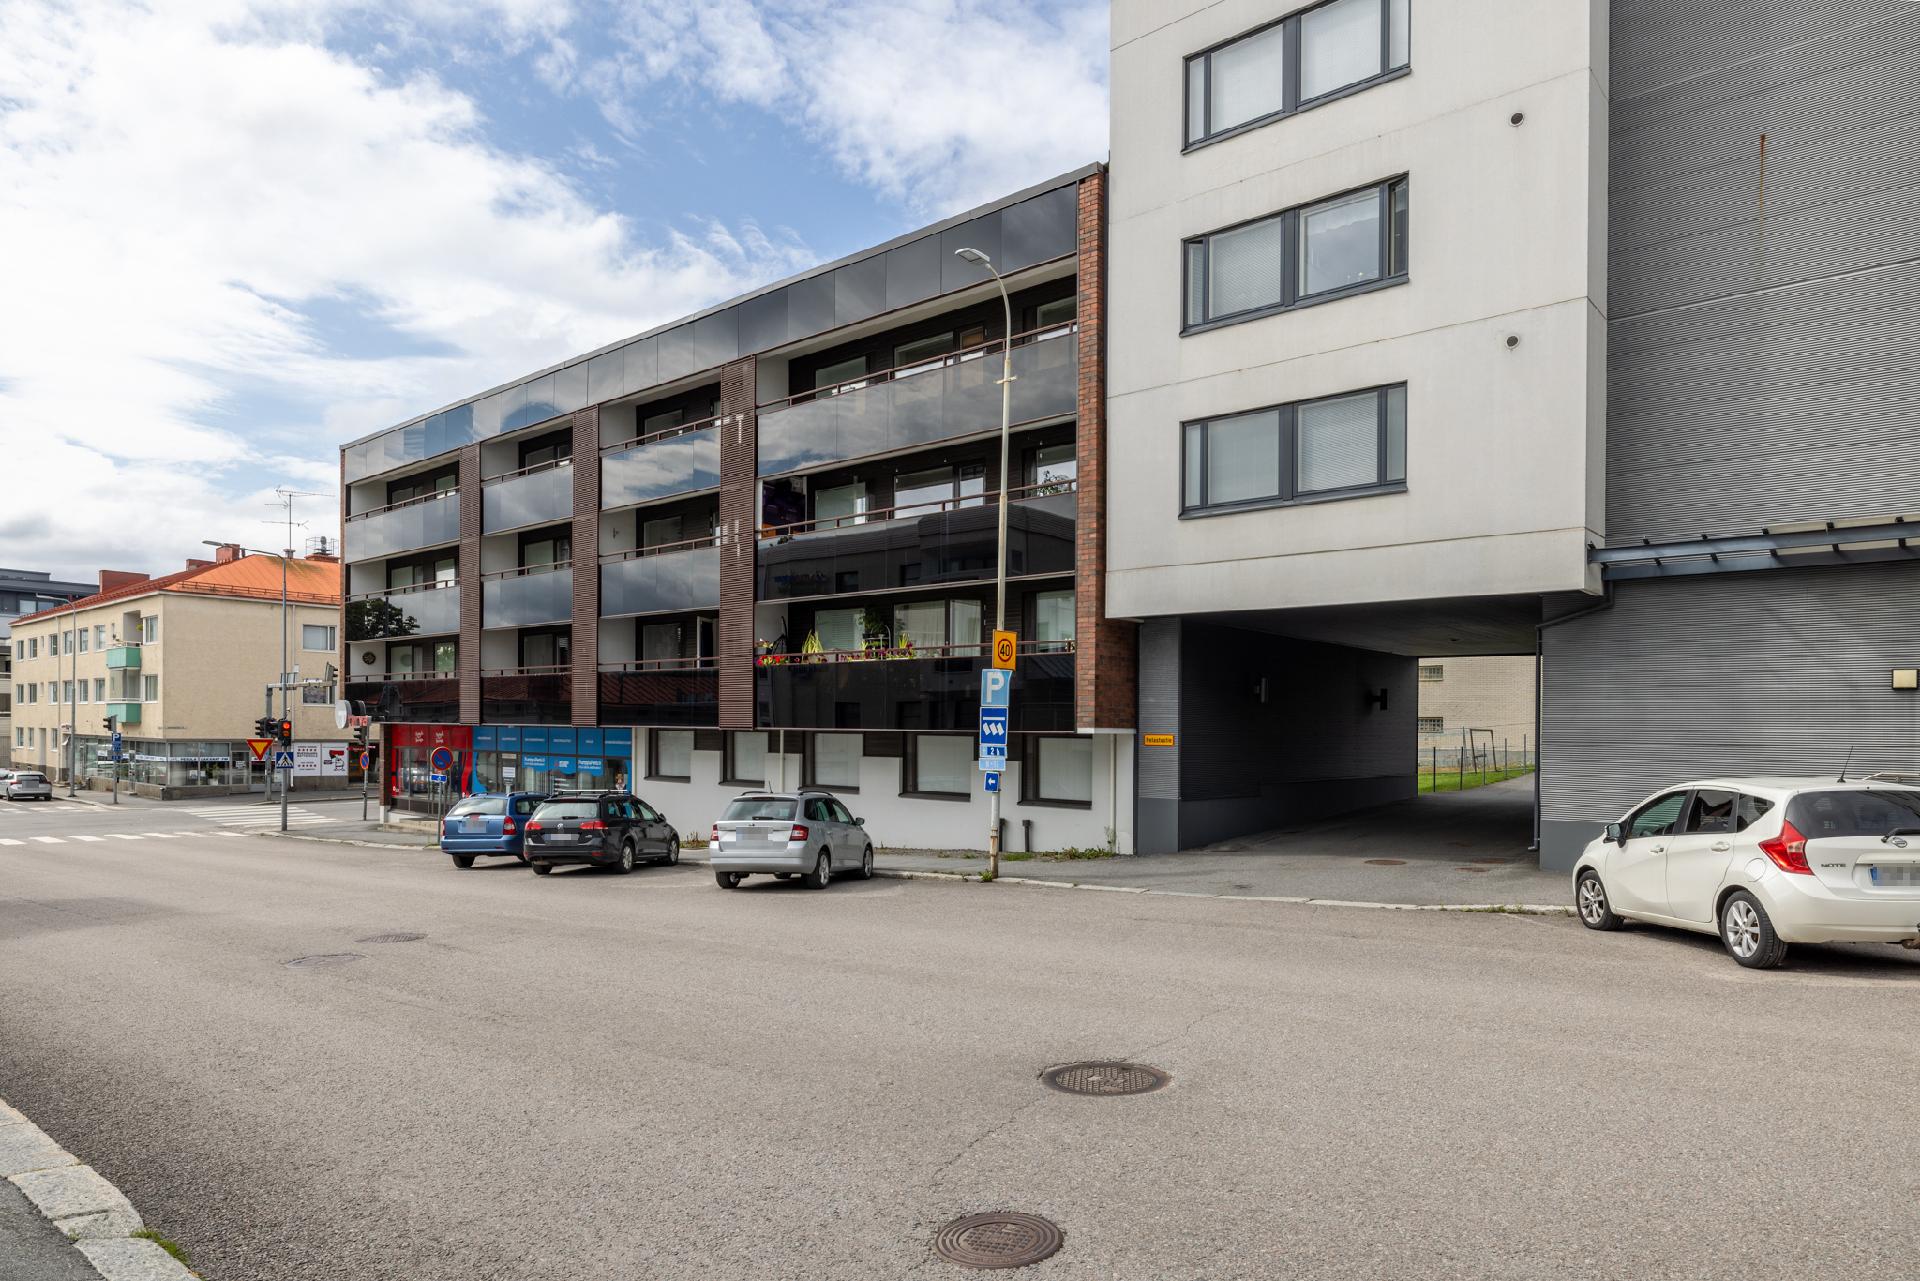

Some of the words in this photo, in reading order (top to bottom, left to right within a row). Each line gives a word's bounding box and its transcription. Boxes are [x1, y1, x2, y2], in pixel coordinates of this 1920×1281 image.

[1000, 643, 1011, 657] 40
[986, 671, 1005, 703] P
[112, 733, 120, 741] P
[990, 747, 995, 755] 2
